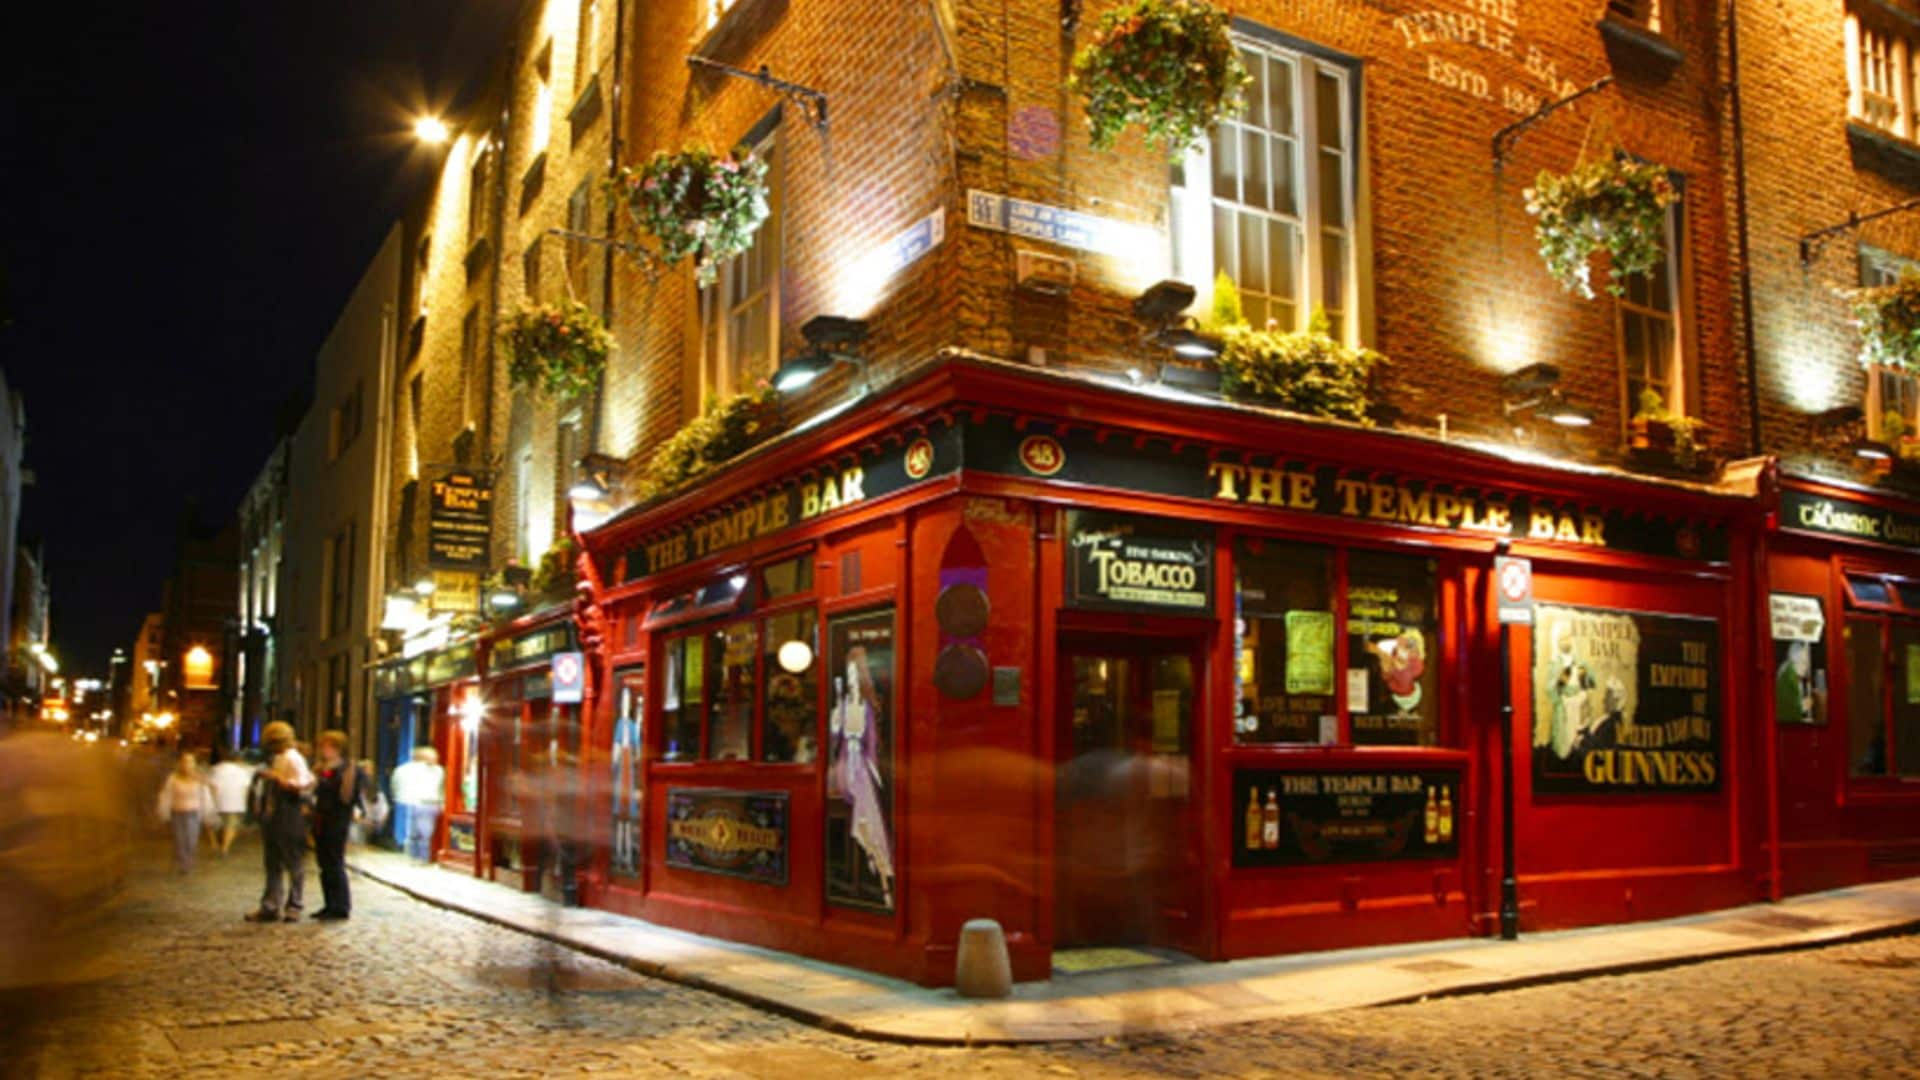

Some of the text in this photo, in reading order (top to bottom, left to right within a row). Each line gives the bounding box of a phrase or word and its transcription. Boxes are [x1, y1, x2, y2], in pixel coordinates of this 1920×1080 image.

[1393, 11, 1514, 57] TEMPLE
[1029, 443, 1053, 466] 48
[646, 467, 865, 572] THE TEMPLE BAR
[1208, 461, 1606, 547] THE TEMPLE BAR
[1090, 550, 1196, 593] TOBACCO
[1281, 775, 1423, 794] THE TEMPLE BAR
[1583, 751, 1716, 784] GUINNESS
